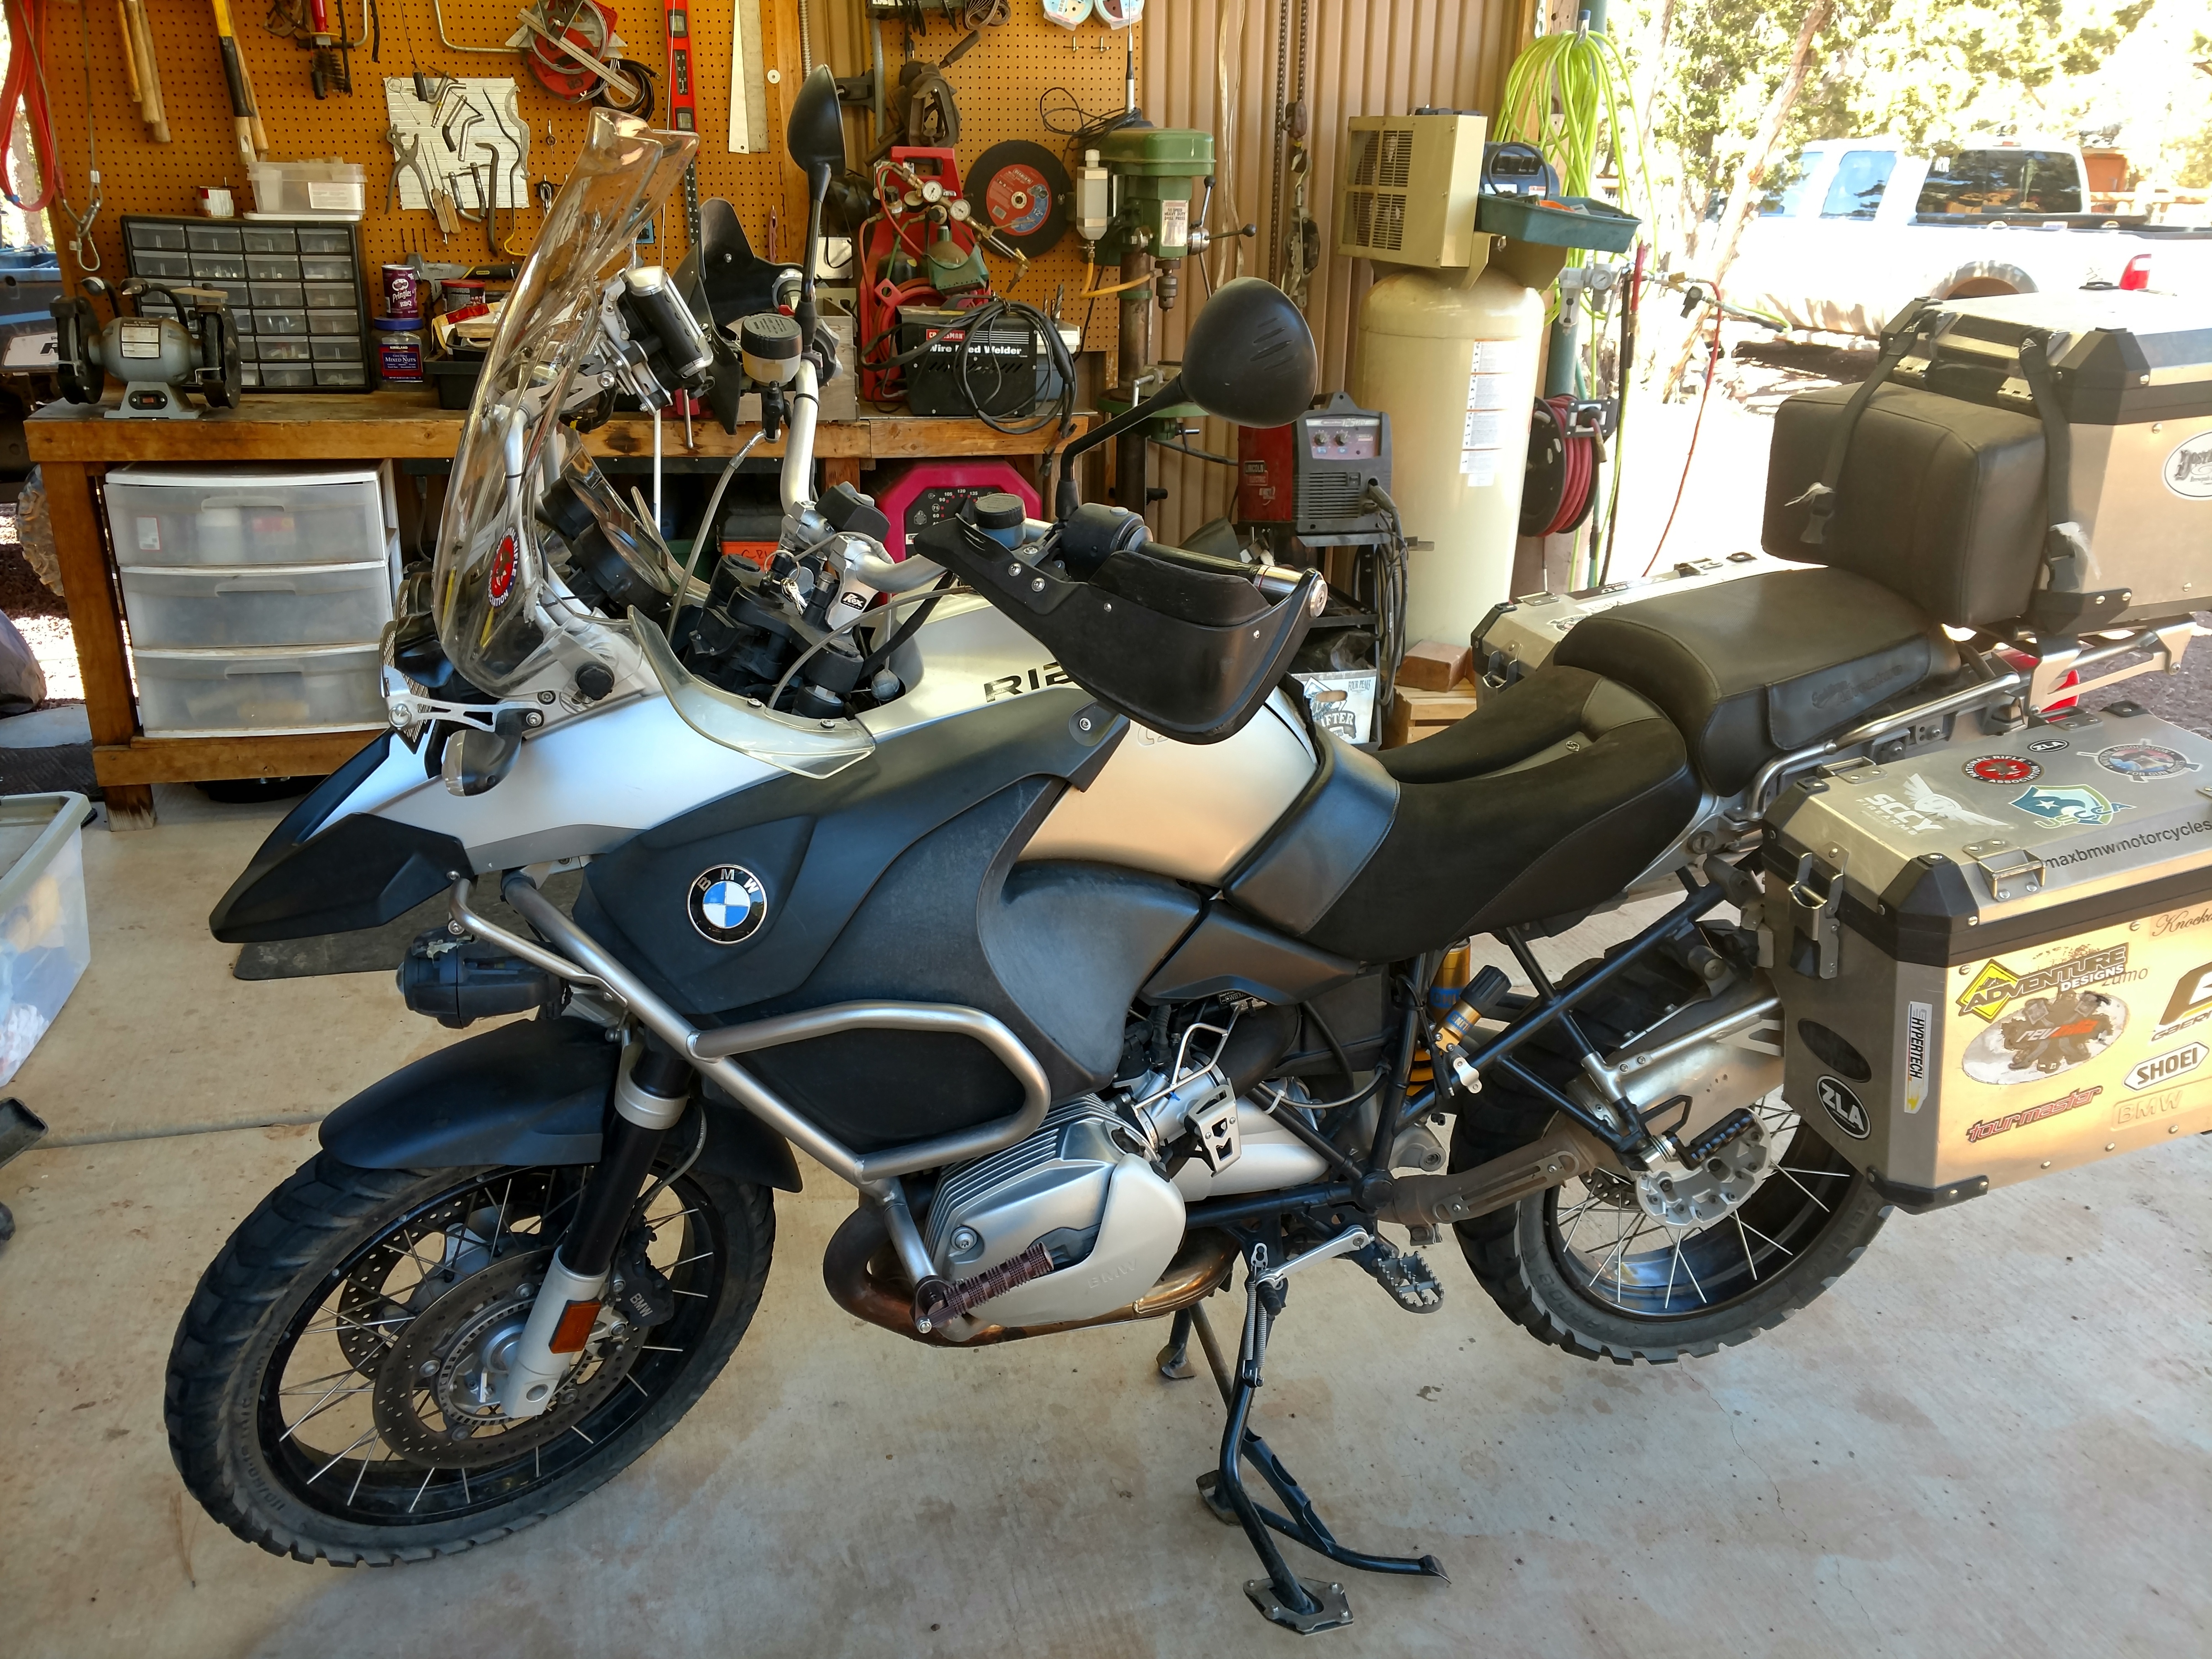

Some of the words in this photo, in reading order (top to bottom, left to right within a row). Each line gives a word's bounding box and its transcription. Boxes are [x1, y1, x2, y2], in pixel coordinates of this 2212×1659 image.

[392, 289, 412, 303] Pringles
[984, 346, 1022, 354] Welder
[1348, 680, 1358, 692] FOUR
[1359, 680, 1371, 690] PEAKS
[2033, 741, 2065, 751] ZLA
[1965, 757, 1991, 778] NATIONAL
[1988, 765, 2041, 784] ASSOCIATION
[1864, 794, 1944, 831] SCCY
[2034, 802, 2138, 829] USCCA
[697, 868, 760, 894] BMW
[1964, 946, 2126, 1013] ADVENTURE
[2061, 964, 2124, 992] DESIGNS
[1909, 1017, 1925, 1079] HYPERTECH
[2137, 1047, 2198, 1085] SHOEI
[1822, 1081, 1863, 1132] ZLA
[1969, 1086, 2102, 1142] tourmaster
[2117, 1089, 2183, 1124] BMW
[630, 1293, 653, 1317] BMW
